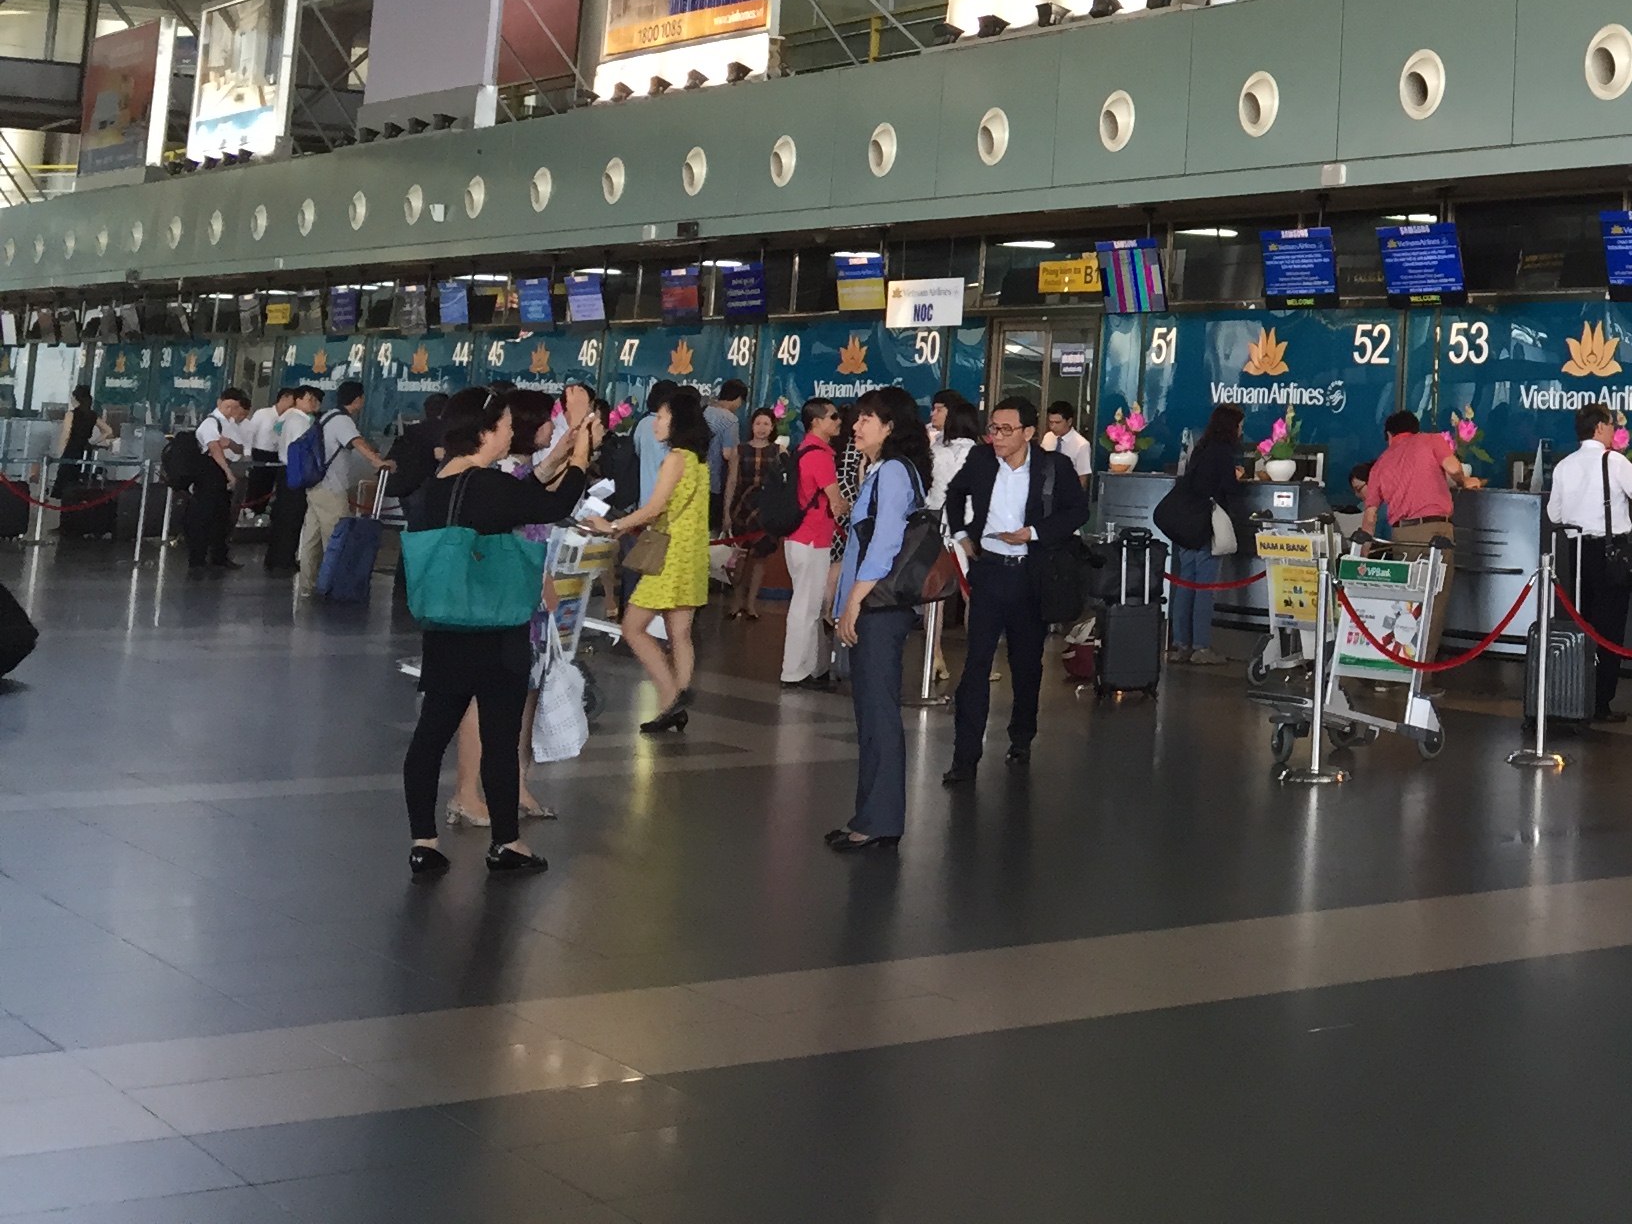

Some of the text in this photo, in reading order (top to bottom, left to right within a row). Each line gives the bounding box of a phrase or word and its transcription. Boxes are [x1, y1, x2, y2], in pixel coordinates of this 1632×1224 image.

[914, 303, 933, 322] NOC
[376, 342, 392, 366] 43
[452, 341, 470, 366] 44
[487, 340, 505, 367] 45
[577, 339, 598, 367] 46
[620, 338, 640, 367] 47
[727, 336, 750, 367] 48
[777, 334, 800, 366] 49
[914, 331, 941, 364] 50
[1150, 327, 1177, 364] 51
[1353, 323, 1391, 364] 52
[1448, 321, 1489, 364] 53
[1259, 542, 1278, 550] NAM
[1286, 544, 1307, 552] BANK
[1367, 565, 1391, 577] VPBank
